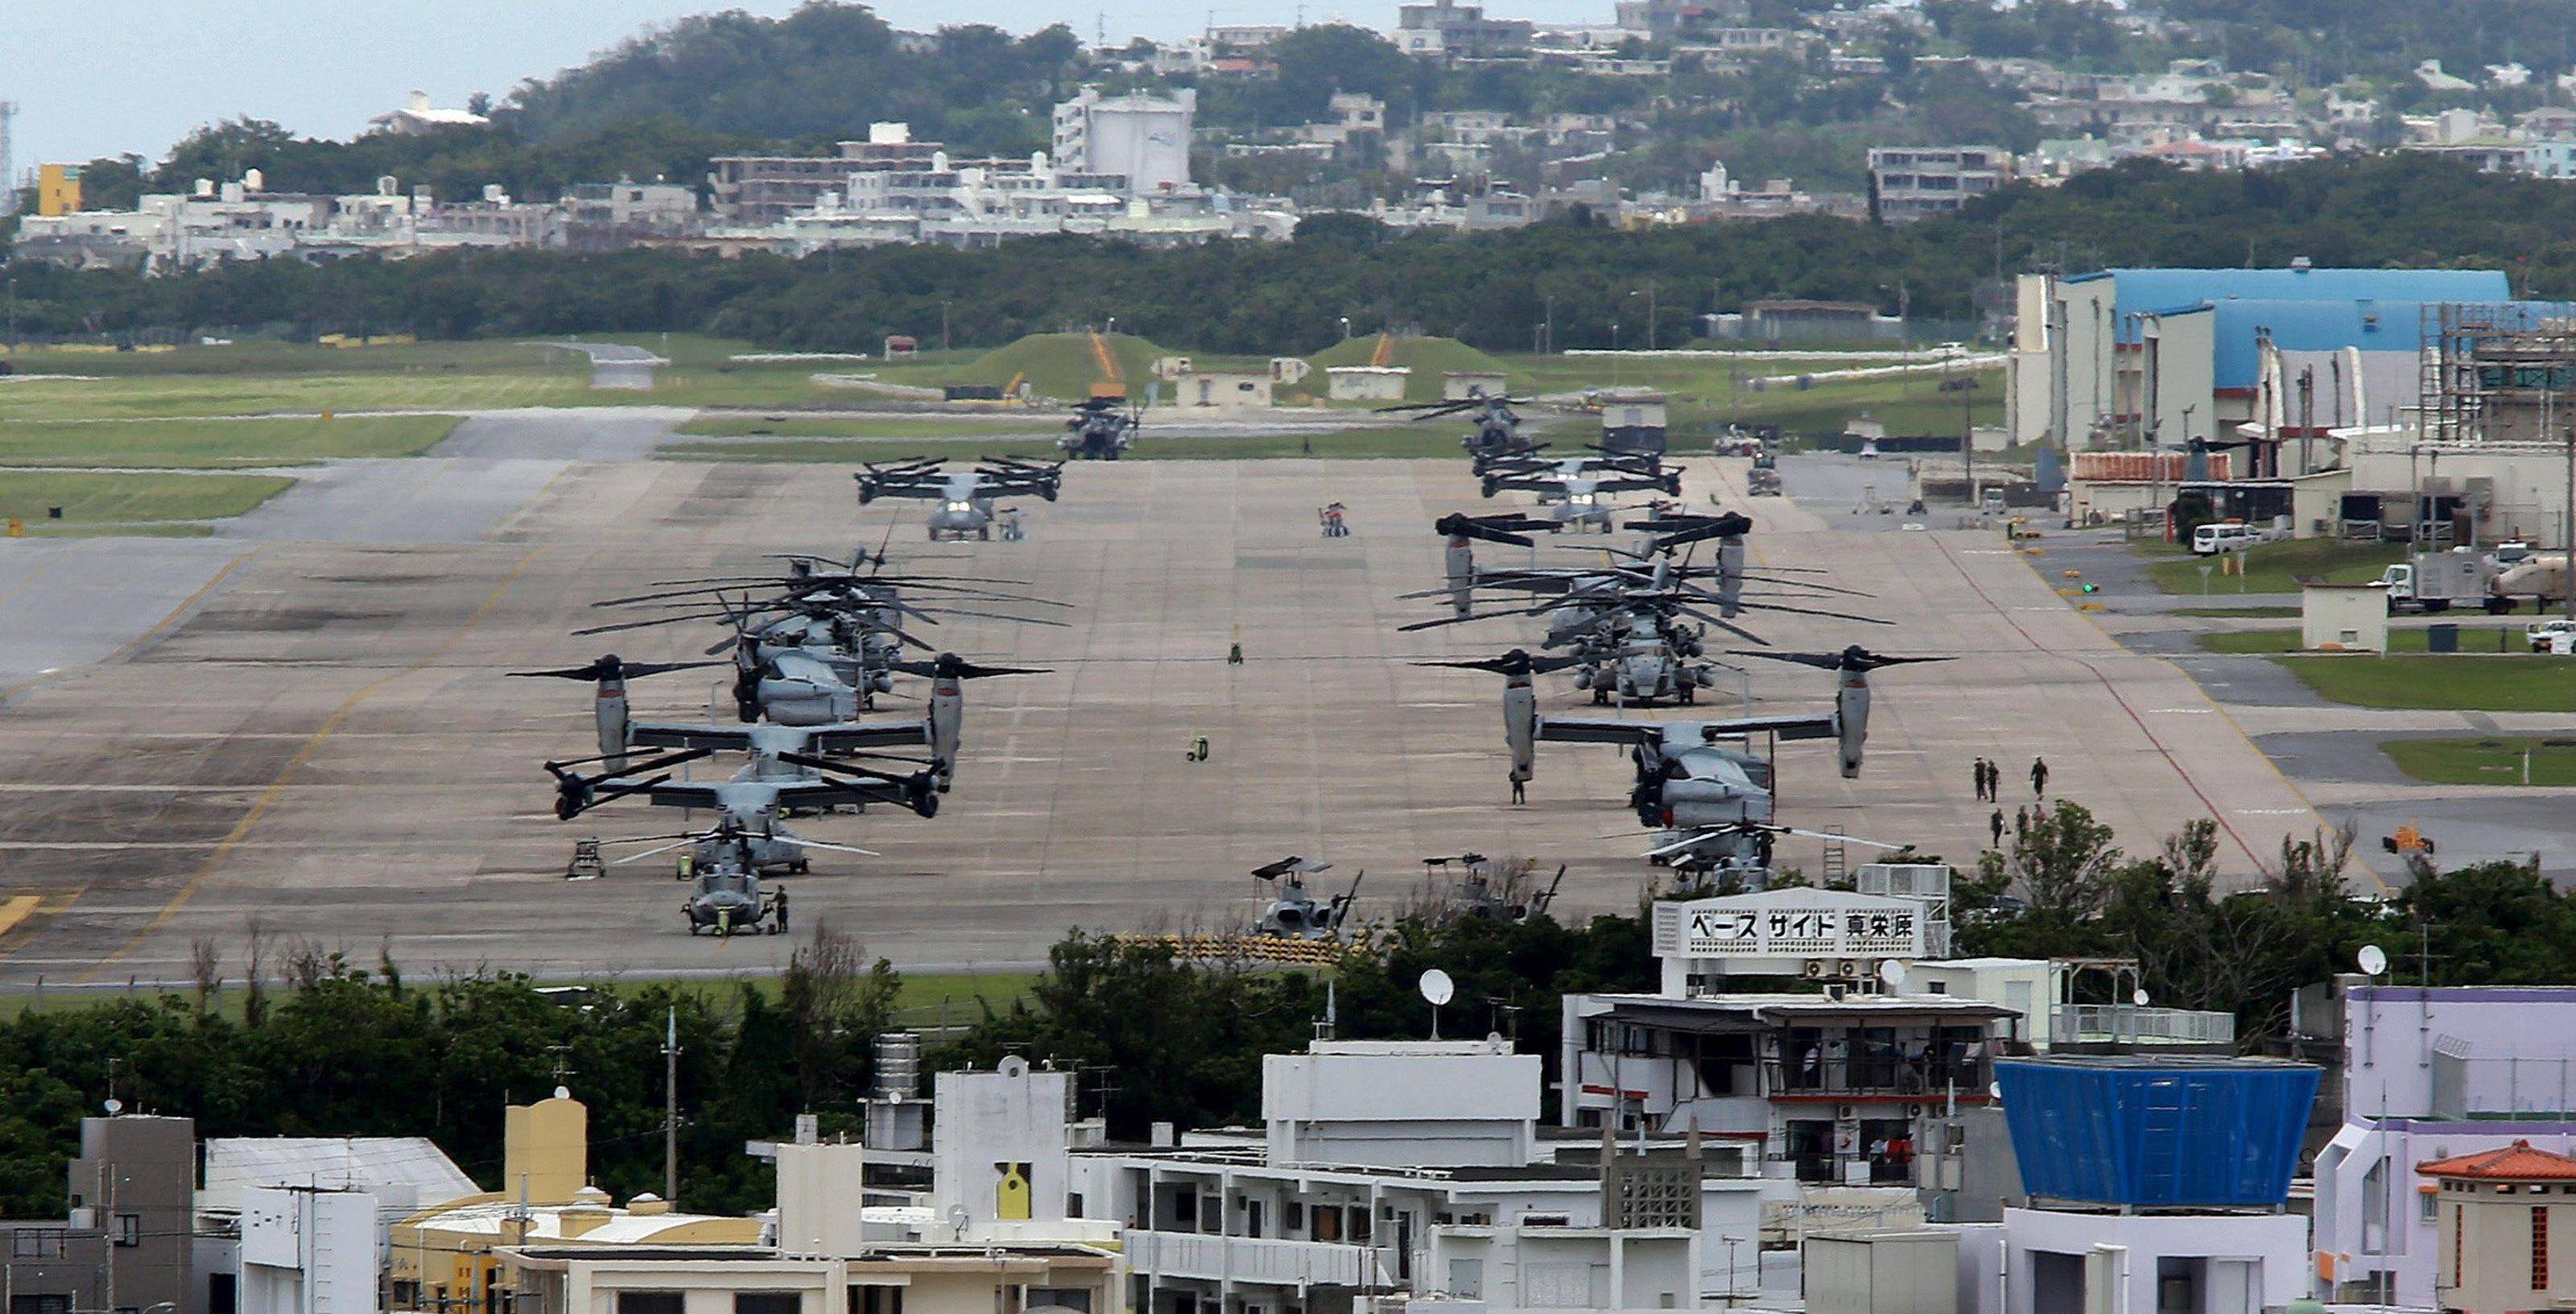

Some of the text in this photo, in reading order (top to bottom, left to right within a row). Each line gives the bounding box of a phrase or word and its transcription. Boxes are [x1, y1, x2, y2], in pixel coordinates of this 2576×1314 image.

[1691, 915, 1914, 937] ベース サイド 真栄原
